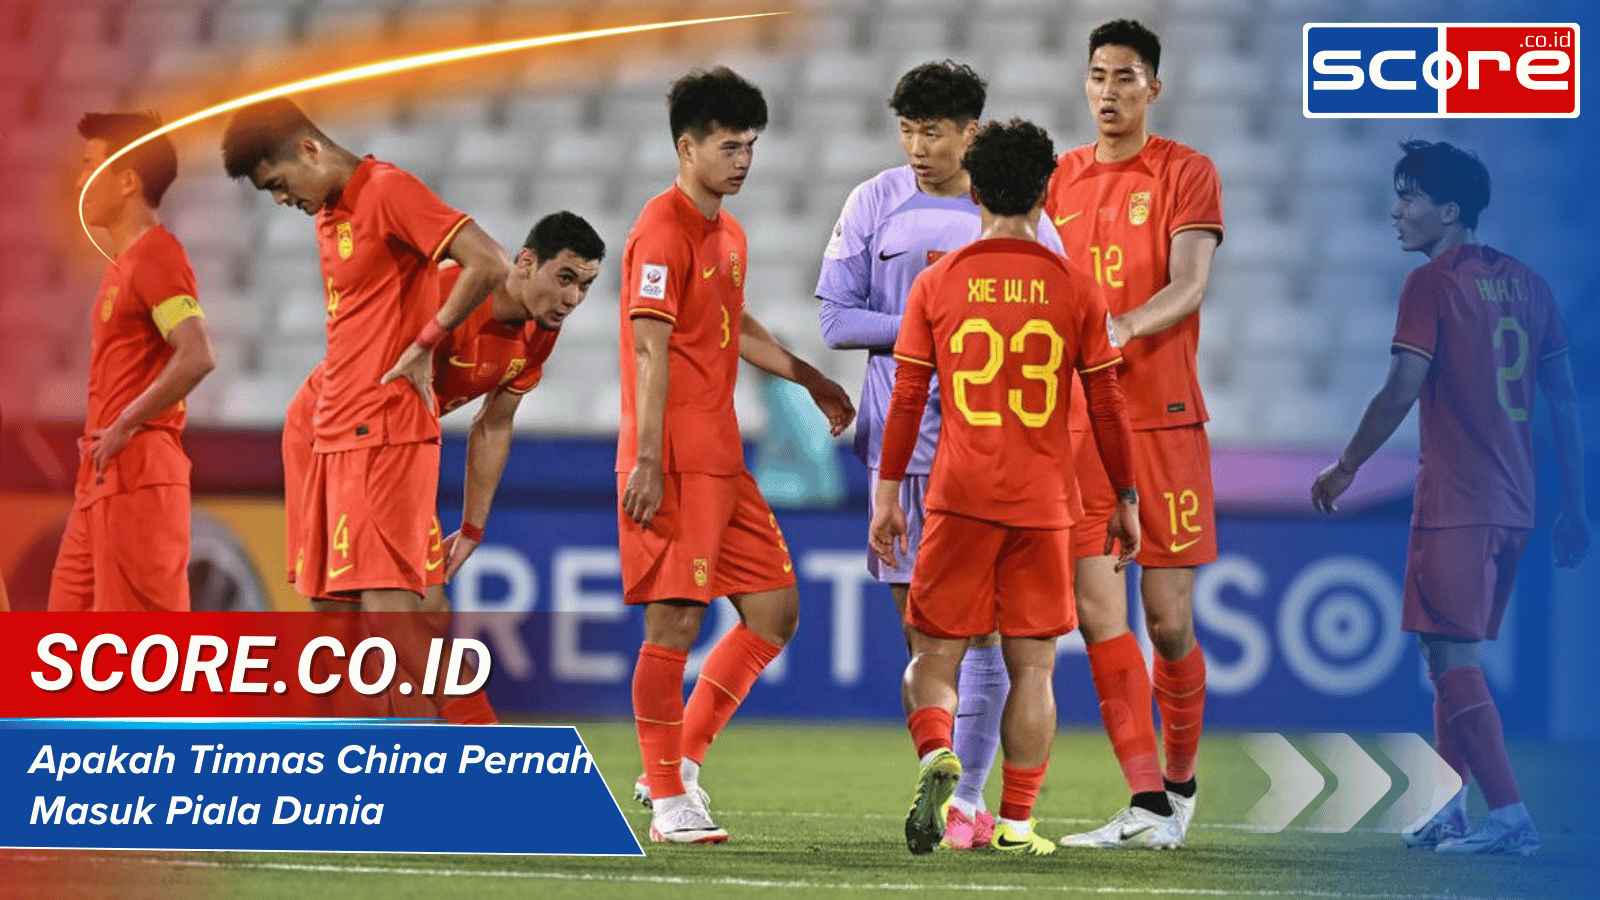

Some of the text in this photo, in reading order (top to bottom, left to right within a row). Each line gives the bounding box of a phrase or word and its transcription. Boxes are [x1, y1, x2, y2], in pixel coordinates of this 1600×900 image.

[1089, 245, 1125, 288] 12
[968, 278, 1049, 304] XIE W.N.
[720, 305, 730, 349] 3
[950, 318, 1065, 428] 23
[1493, 316, 1529, 422] 2
[1163, 490, 1202, 534] 12
[332, 513, 349, 558] 4
